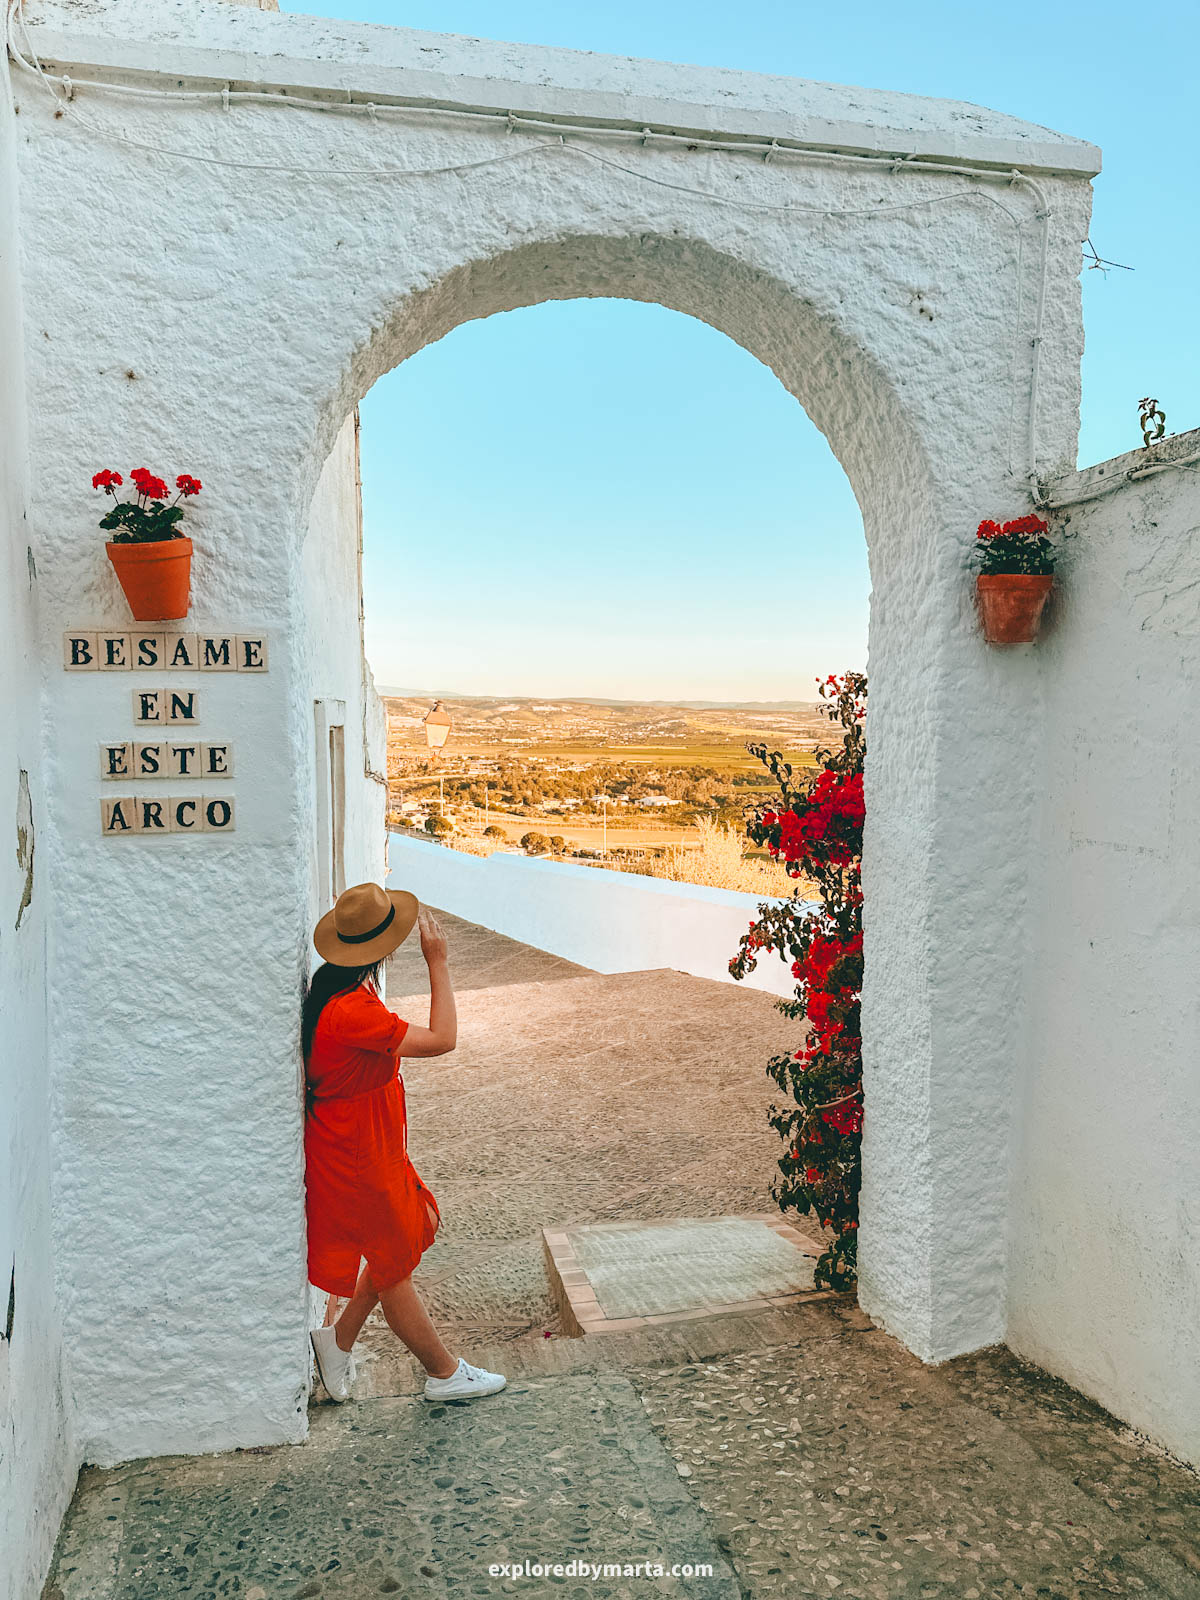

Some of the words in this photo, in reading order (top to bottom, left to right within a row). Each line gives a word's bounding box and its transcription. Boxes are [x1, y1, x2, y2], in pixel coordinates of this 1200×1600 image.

[69, 637, 263, 668] BESAME
[137, 692, 195, 721] EN
[106, 746, 228, 775] ESTE
[107, 800, 232, 831] ARCO
